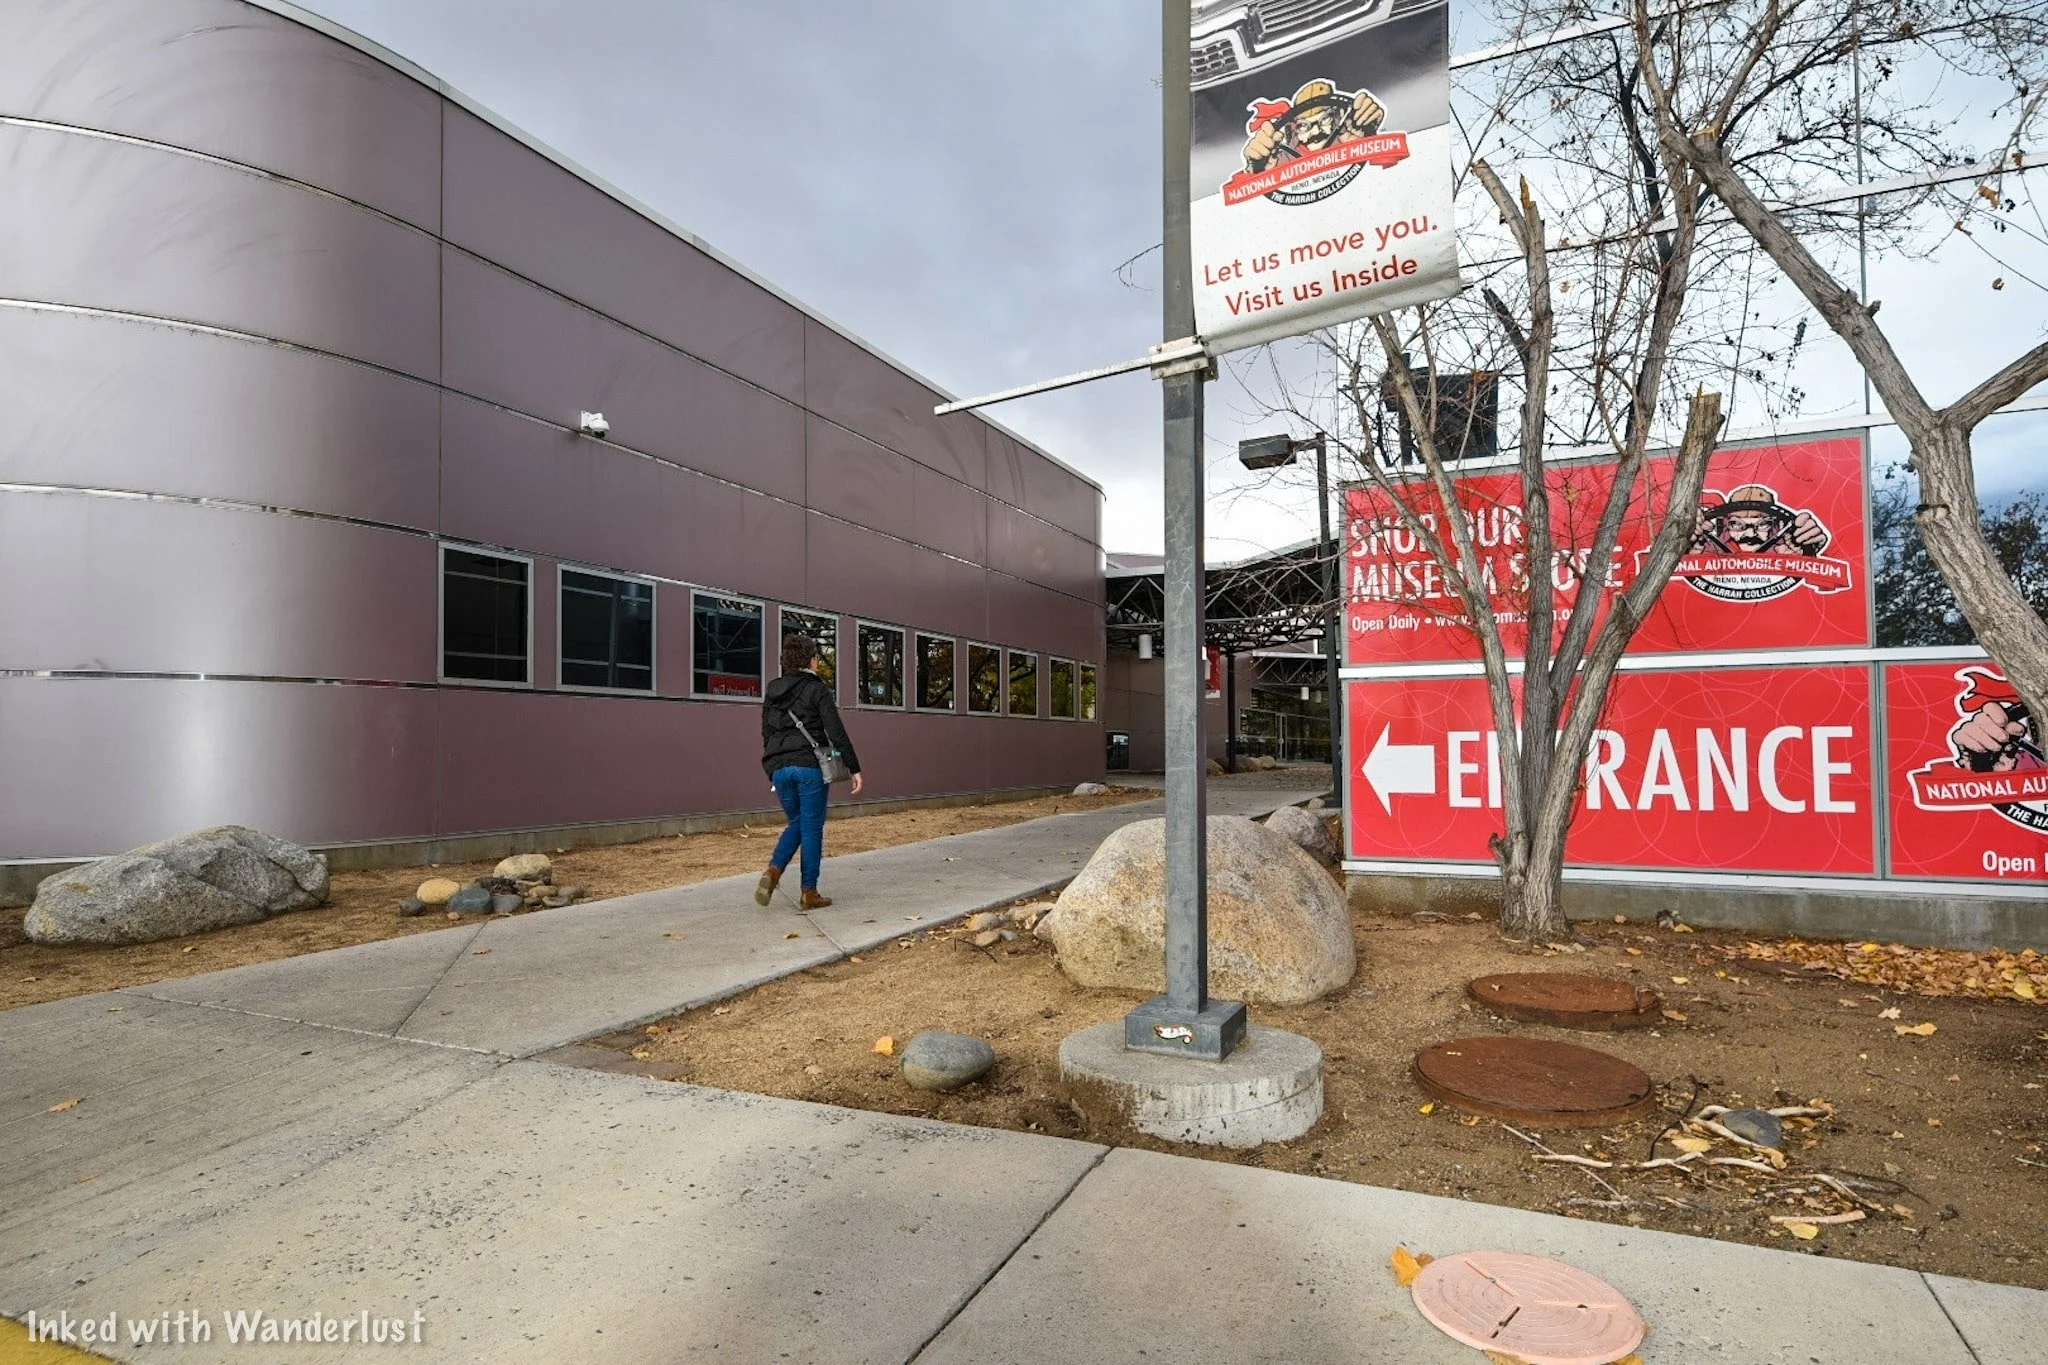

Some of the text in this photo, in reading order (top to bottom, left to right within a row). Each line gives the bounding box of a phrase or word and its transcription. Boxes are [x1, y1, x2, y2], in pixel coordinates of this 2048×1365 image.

[1229, 138, 1401, 200] NATIONAL AUTOMOBILE MUSEUM
[1312, 170, 1340, 184] NEVADA
[1271, 163, 1361, 205] THE HARRAH COLLECTION
[1204, 215, 1438, 286] Let us move you.
[1225, 255, 1418, 316] Visit us Inside
[1510, 545, 1624, 591] SOE
[1705, 558, 1782, 571] AUTOMOBILE
[1785, 559, 1841, 578] MUSEUM
[1693, 576, 1796, 599] THE HARRAH COLLECTION
[1351, 615, 1384, 634] Open
[1388, 612, 1421, 632] Daily
[1447, 725, 1856, 814] ERANCE
[1926, 776, 2048, 799] NATIONAL AU
[2006, 804, 2033, 823] THE
[1982, 850, 2036, 876] Open
